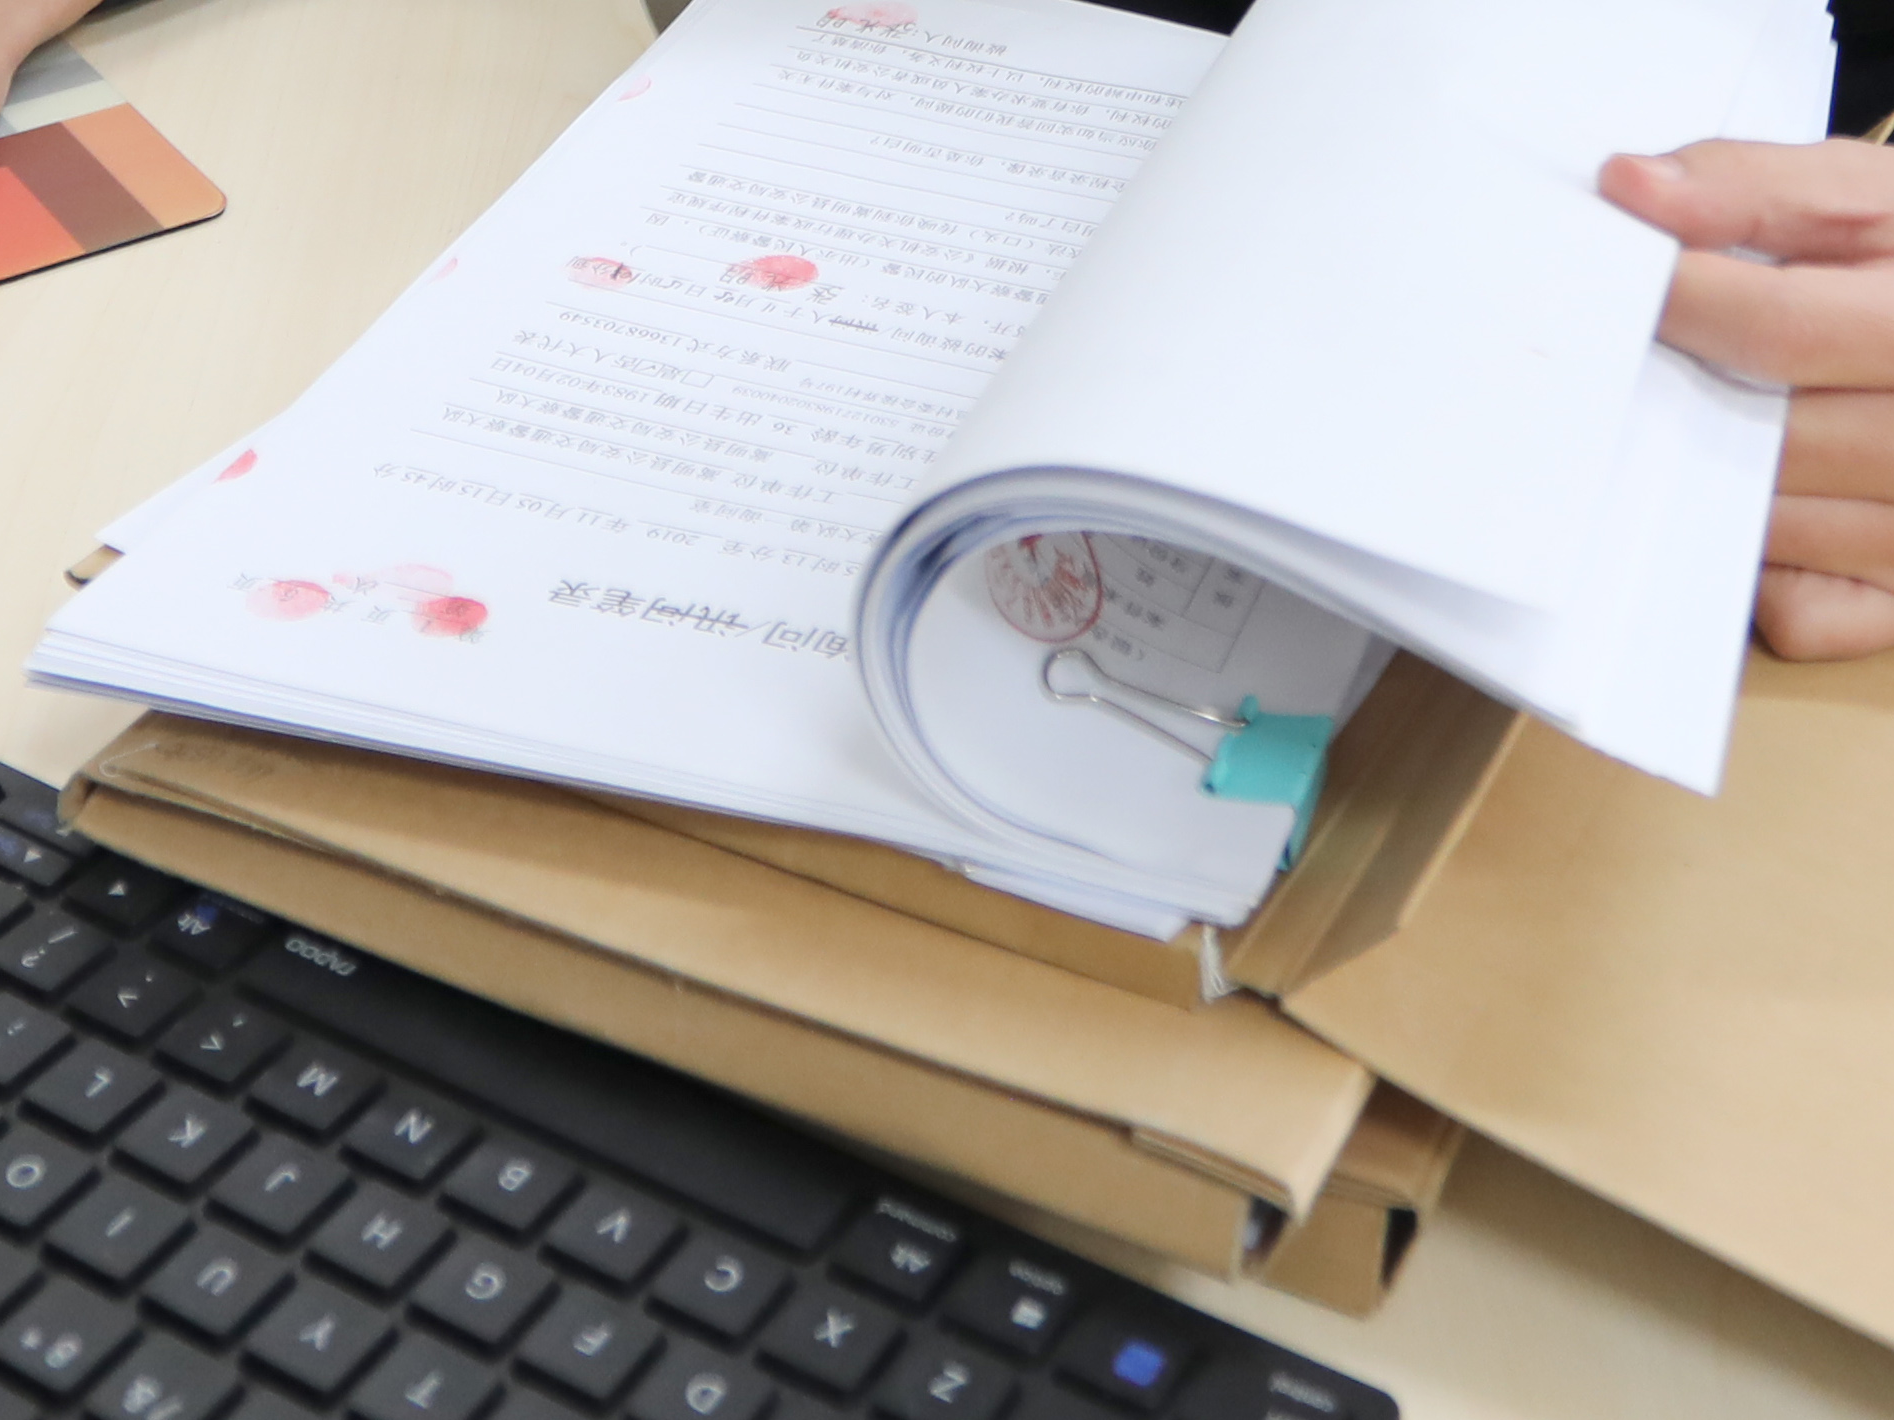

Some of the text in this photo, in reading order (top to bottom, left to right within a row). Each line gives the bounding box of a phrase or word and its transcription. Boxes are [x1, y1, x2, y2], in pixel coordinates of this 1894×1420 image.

[84, 1067, 114, 1099] L
[296, 1063, 341, 1097] M
[168, 1112, 205, 1148] K
[394, 1107, 436, 1145] N
[264, 1163, 301, 1192] J
[497, 1158, 535, 1192] B
[361, 1214, 403, 1250] H
[595, 1205, 633, 1243] V
[196, 1257, 239, 1297] U
[463, 1261, 506, 1301] G
[704, 1256, 745, 1294] C
[300, 1310, 338, 1352] Y
[572, 1319, 614, 1357] F
[813, 1305, 857, 1349] X
[405, 1369, 444, 1410] T
[684, 1371, 729, 1416] D
[927, 1359, 973, 1406] Z
